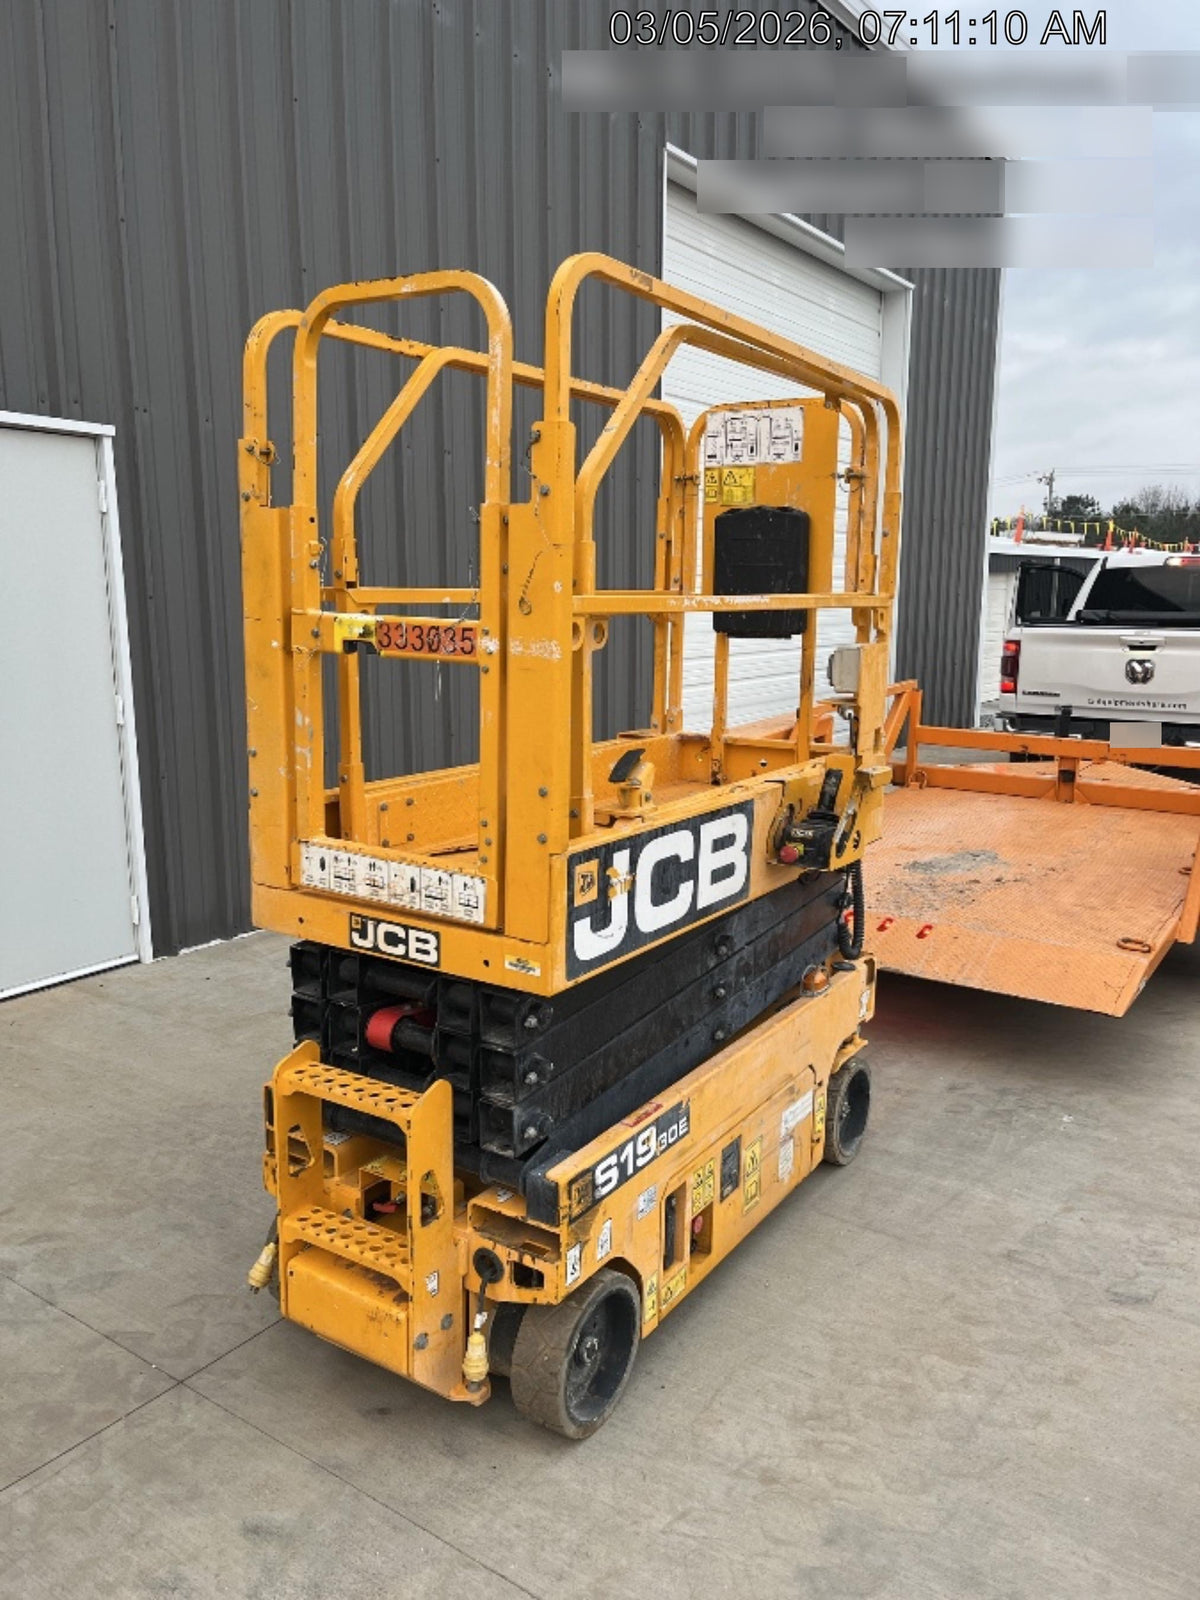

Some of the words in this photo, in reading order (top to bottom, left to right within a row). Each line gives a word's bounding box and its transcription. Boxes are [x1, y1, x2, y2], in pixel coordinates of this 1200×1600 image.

[377, 622, 475, 655] 333035
[573, 812, 748, 961] JCB
[351, 917, 439, 964] JCB
